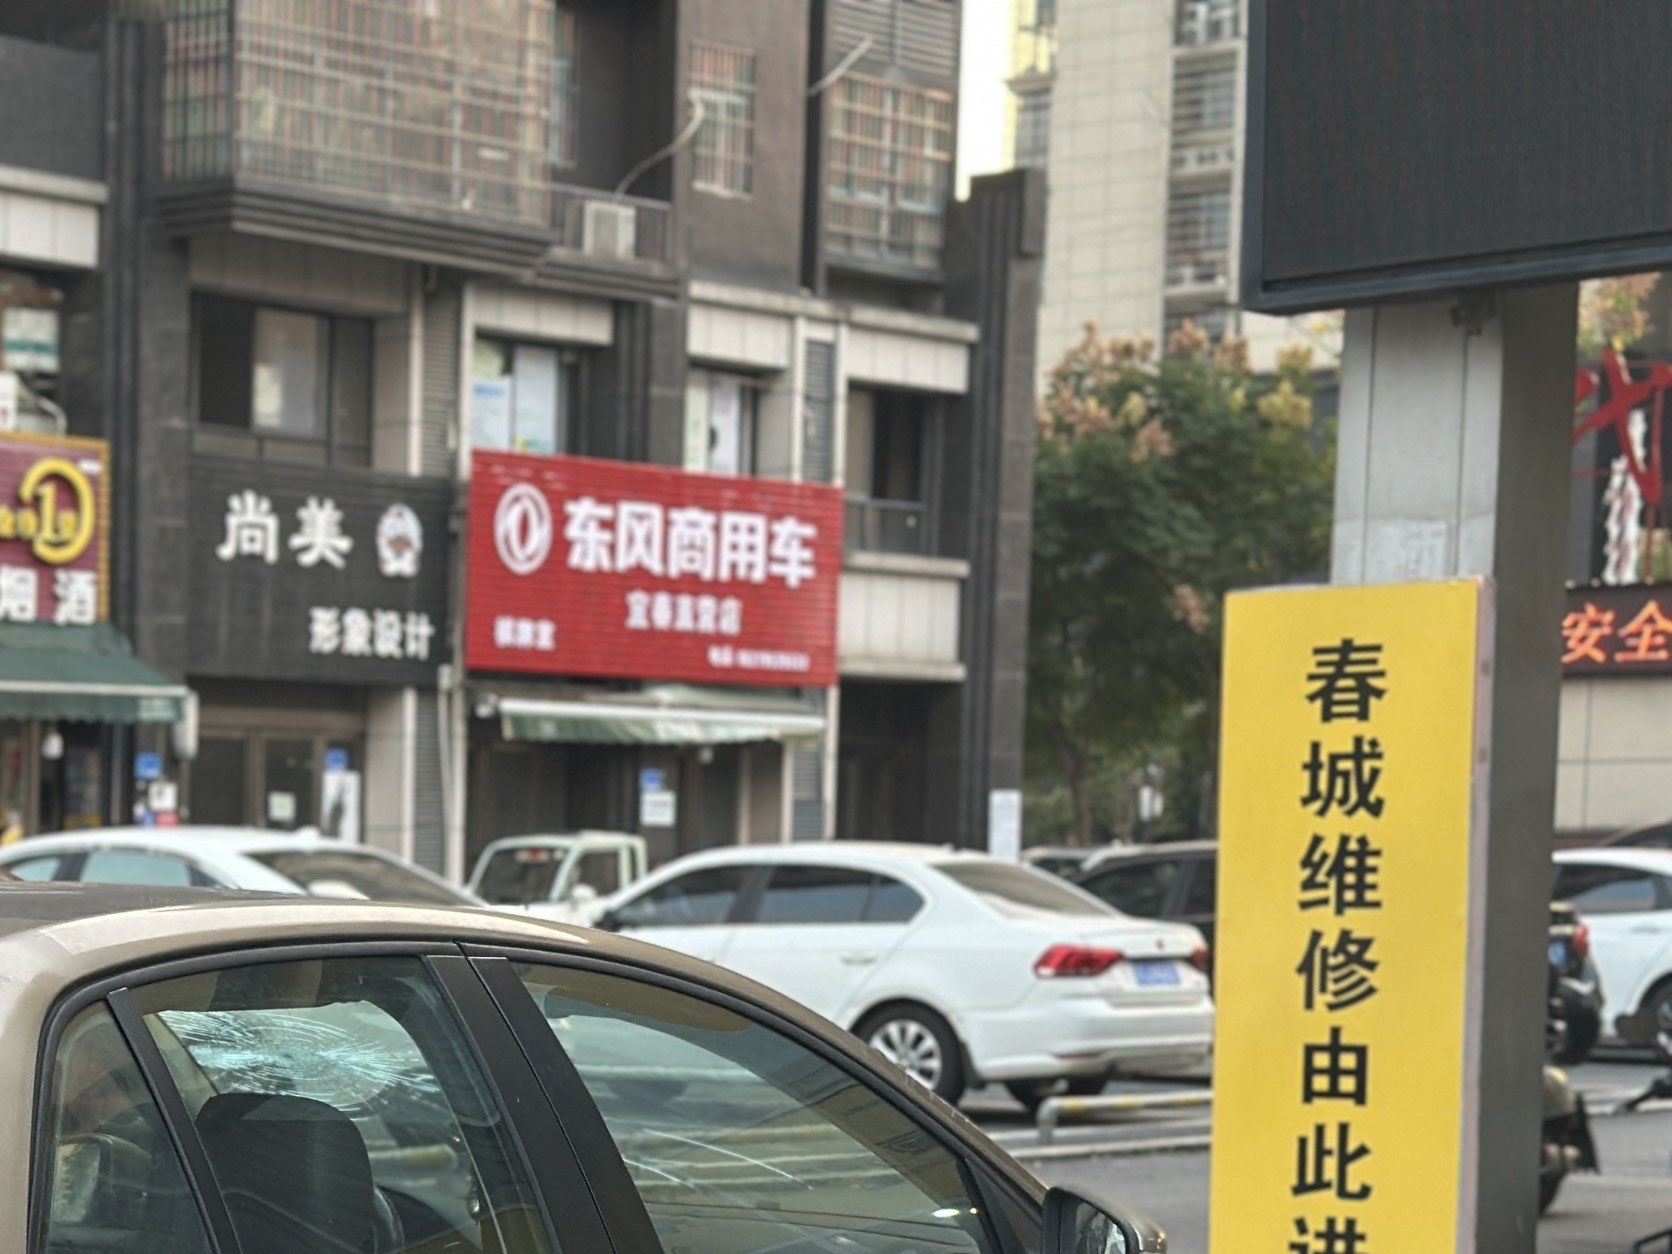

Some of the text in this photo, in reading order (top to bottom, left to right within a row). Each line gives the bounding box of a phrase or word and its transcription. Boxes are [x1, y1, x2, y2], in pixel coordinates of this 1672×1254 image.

[216, 489, 354, 570] 尚美
[563, 496, 817, 589] 东风商用车
[309, 606, 436, 661] 形象设计
[1561, 601, 1672, 664] 安全
